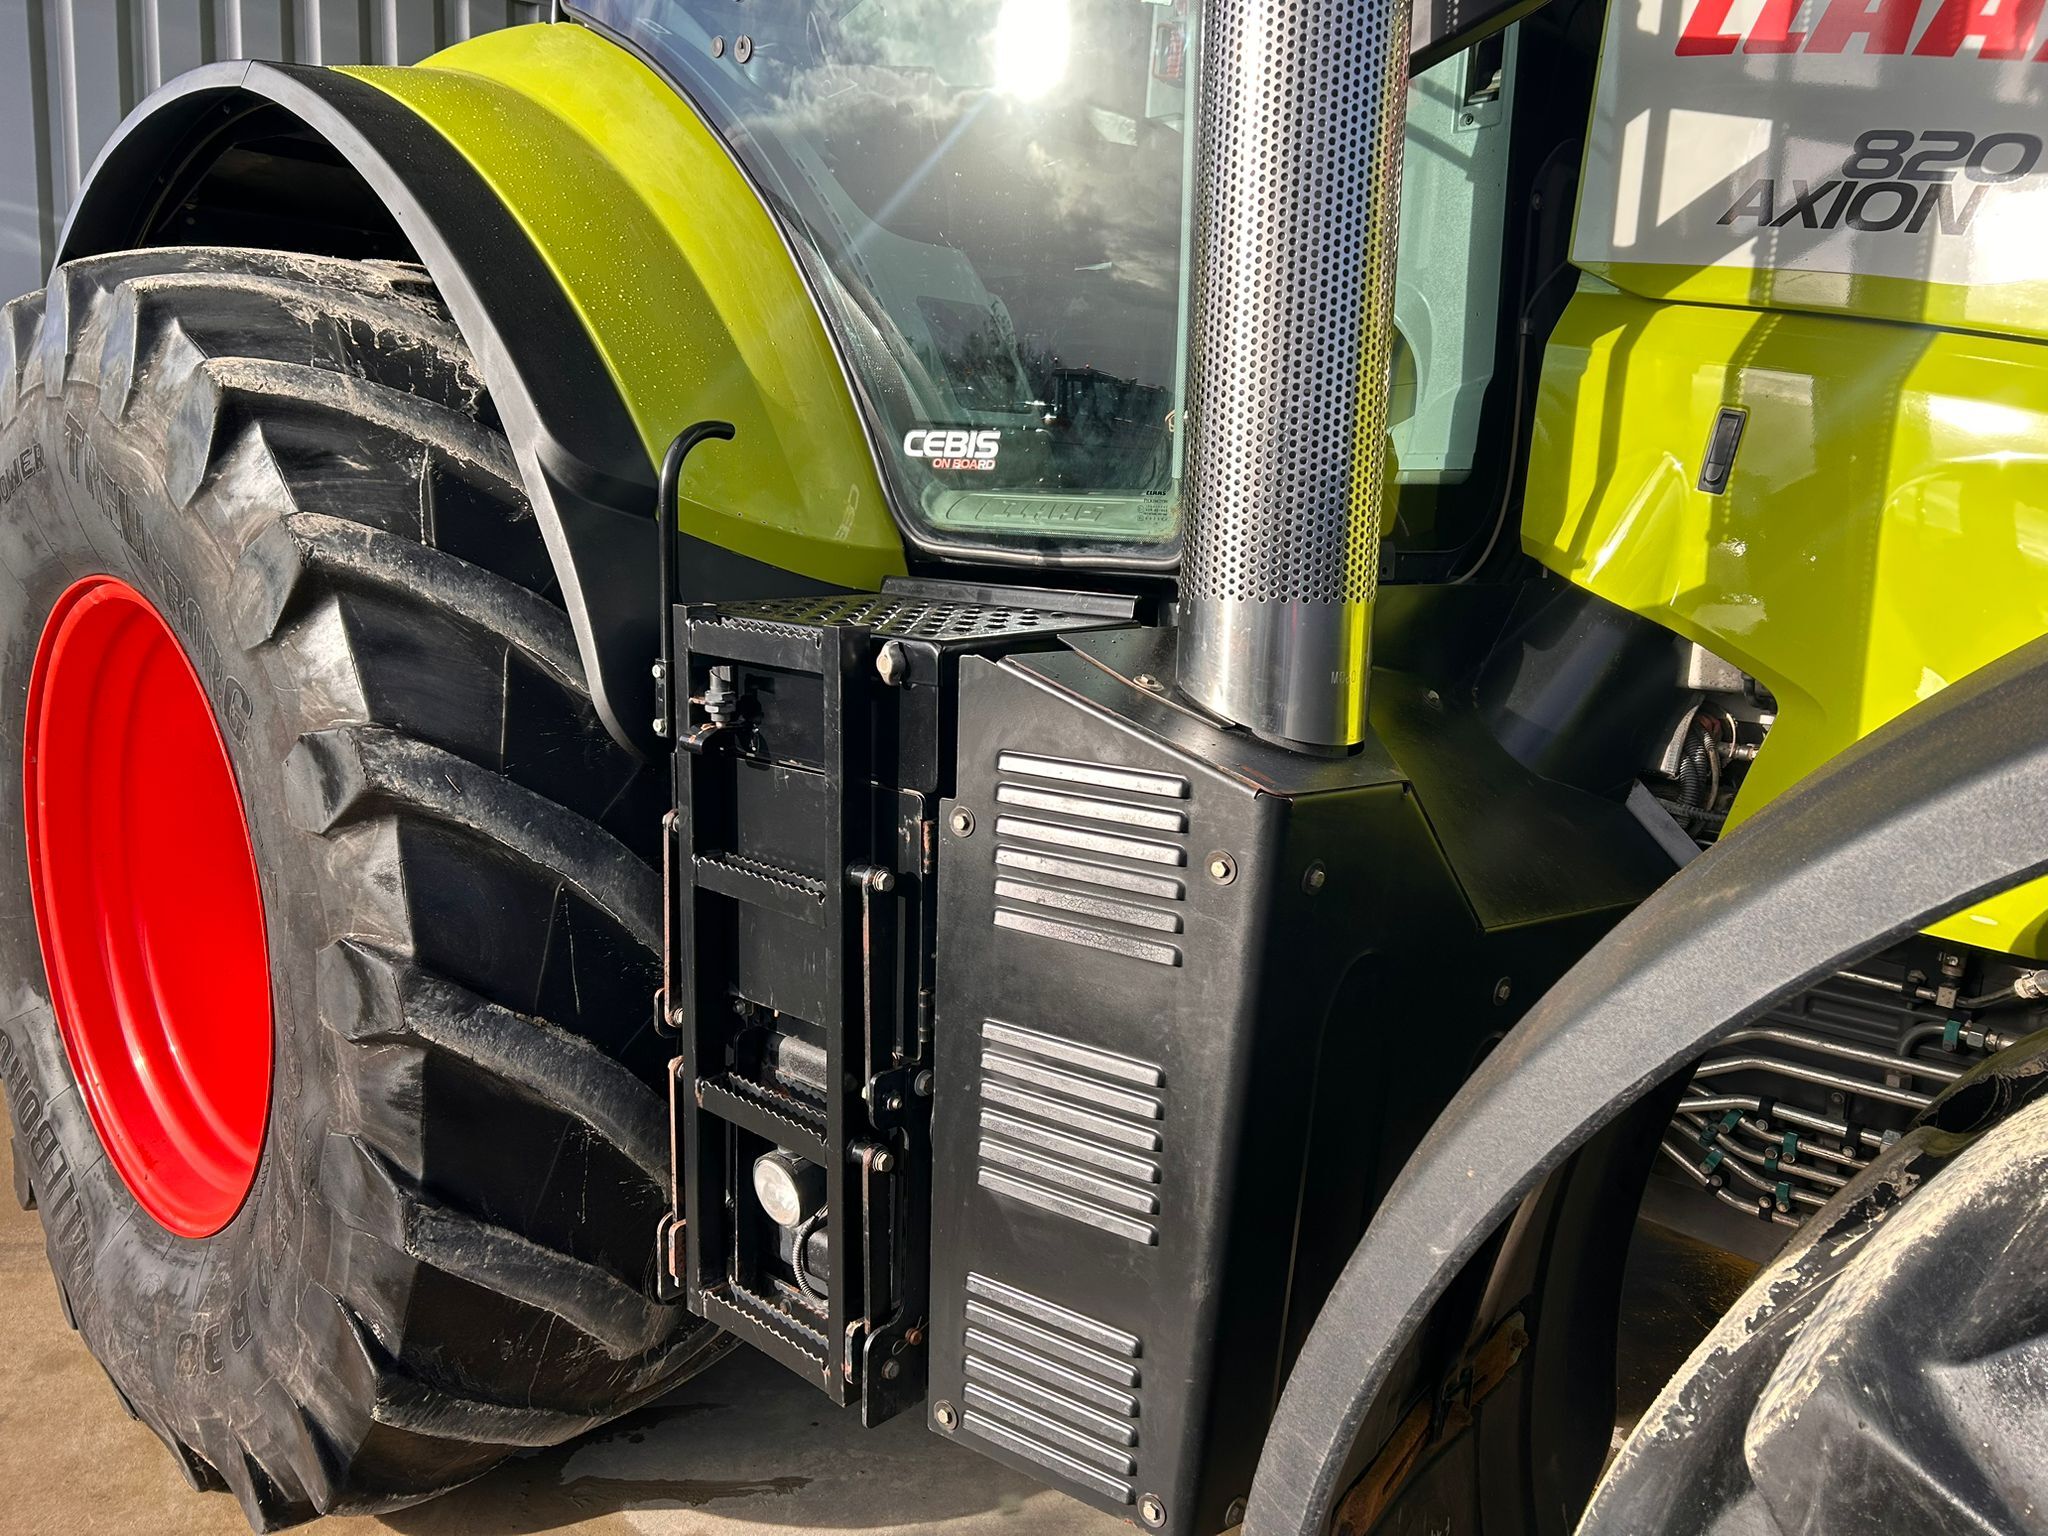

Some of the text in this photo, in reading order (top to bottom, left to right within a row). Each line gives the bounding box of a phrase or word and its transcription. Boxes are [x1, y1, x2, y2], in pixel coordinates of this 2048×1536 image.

[1841, 129, 2043, 184] 820
[1716, 179, 1992, 236] AXION
[903, 429, 1001, 458] CEBIS
[932, 458, 996, 471] ON BOARD
[0, 442, 47, 504] OWER
